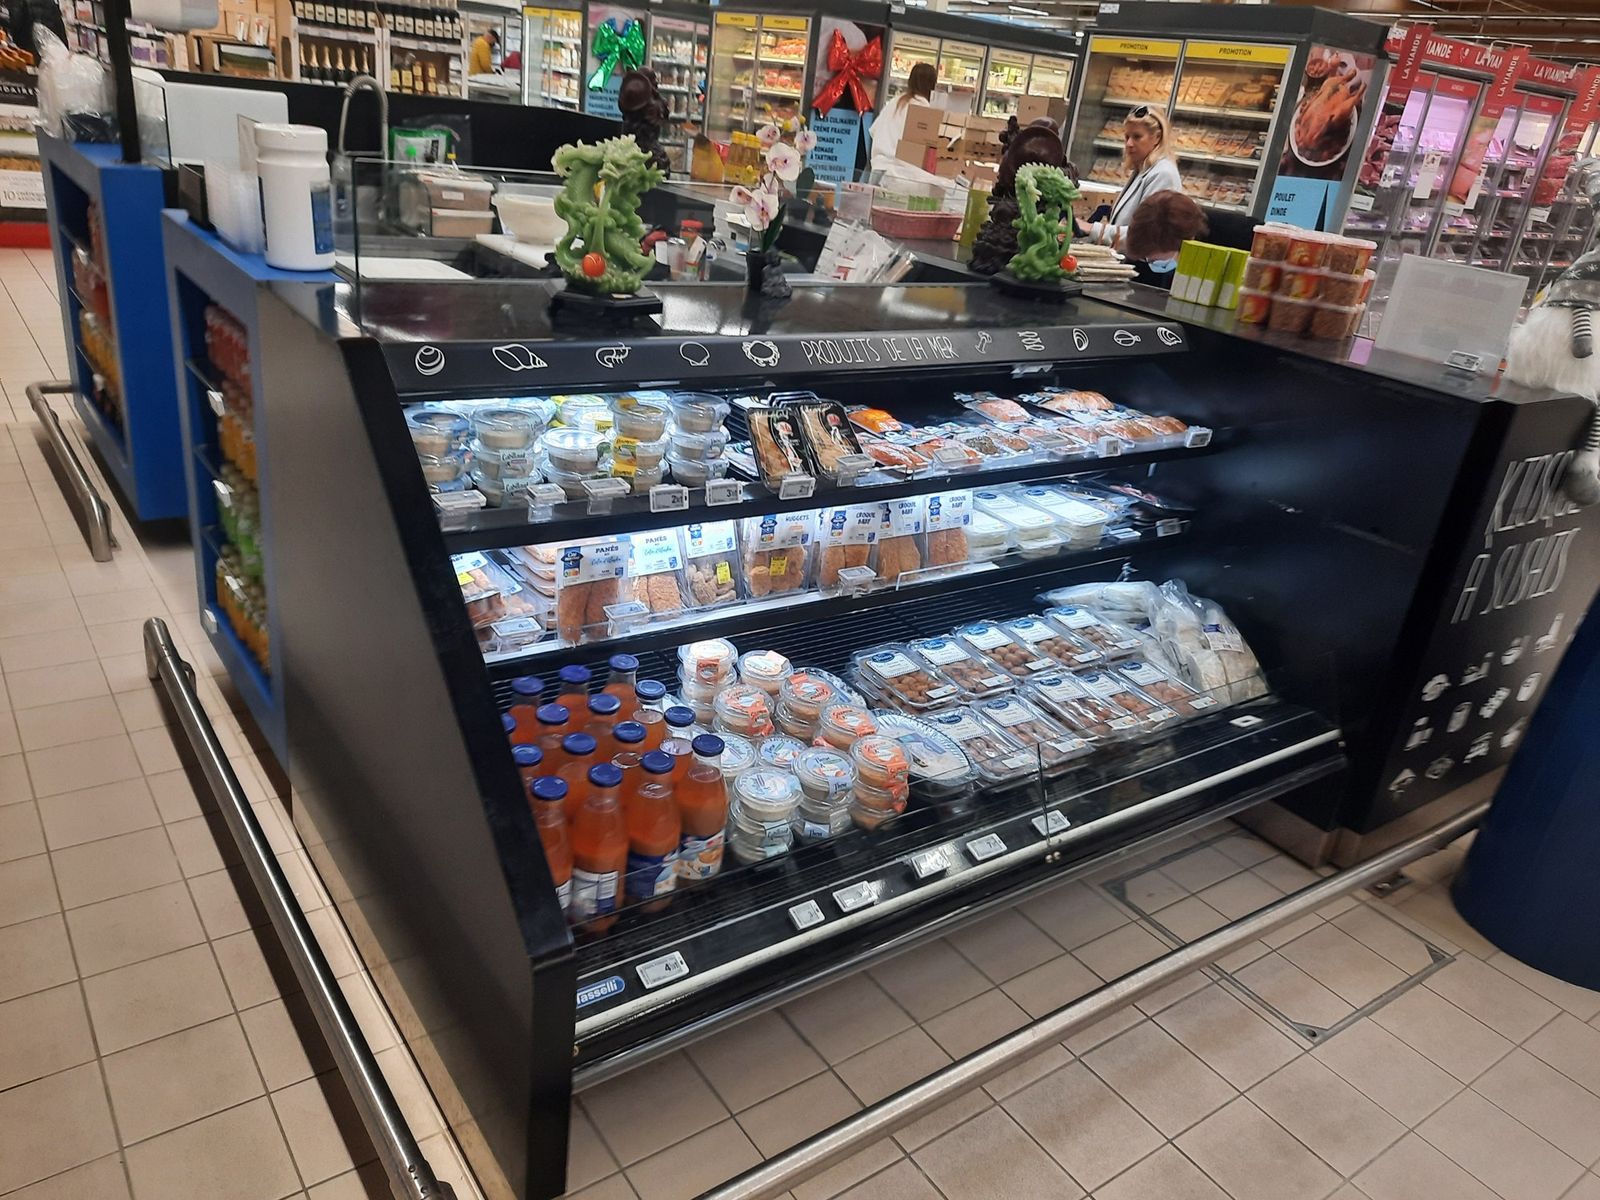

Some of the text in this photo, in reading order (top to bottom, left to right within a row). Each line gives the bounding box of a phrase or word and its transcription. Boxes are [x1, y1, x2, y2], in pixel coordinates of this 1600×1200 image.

[1119, 43, 1149, 51] PROMOTION
[1218, 47, 1252, 56] PROMOTION
[1401, 33, 1423, 80] LA VIANDE
[1533, 64, 1543, 78] LA
[1497, 55, 1520, 97] LA VIANDE
[1581, 102, 1590, 112] LA
[829, 117, 858, 126] CULINAIRES
[814, 146, 834, 154] ROMAGE
[814, 154, 838, 162] TARTINER
[1274, 192, 1296, 202] POULET
[1270, 207, 1287, 216] DINDE
[800, 335, 960, 365] PRODUITS DE LA MER
